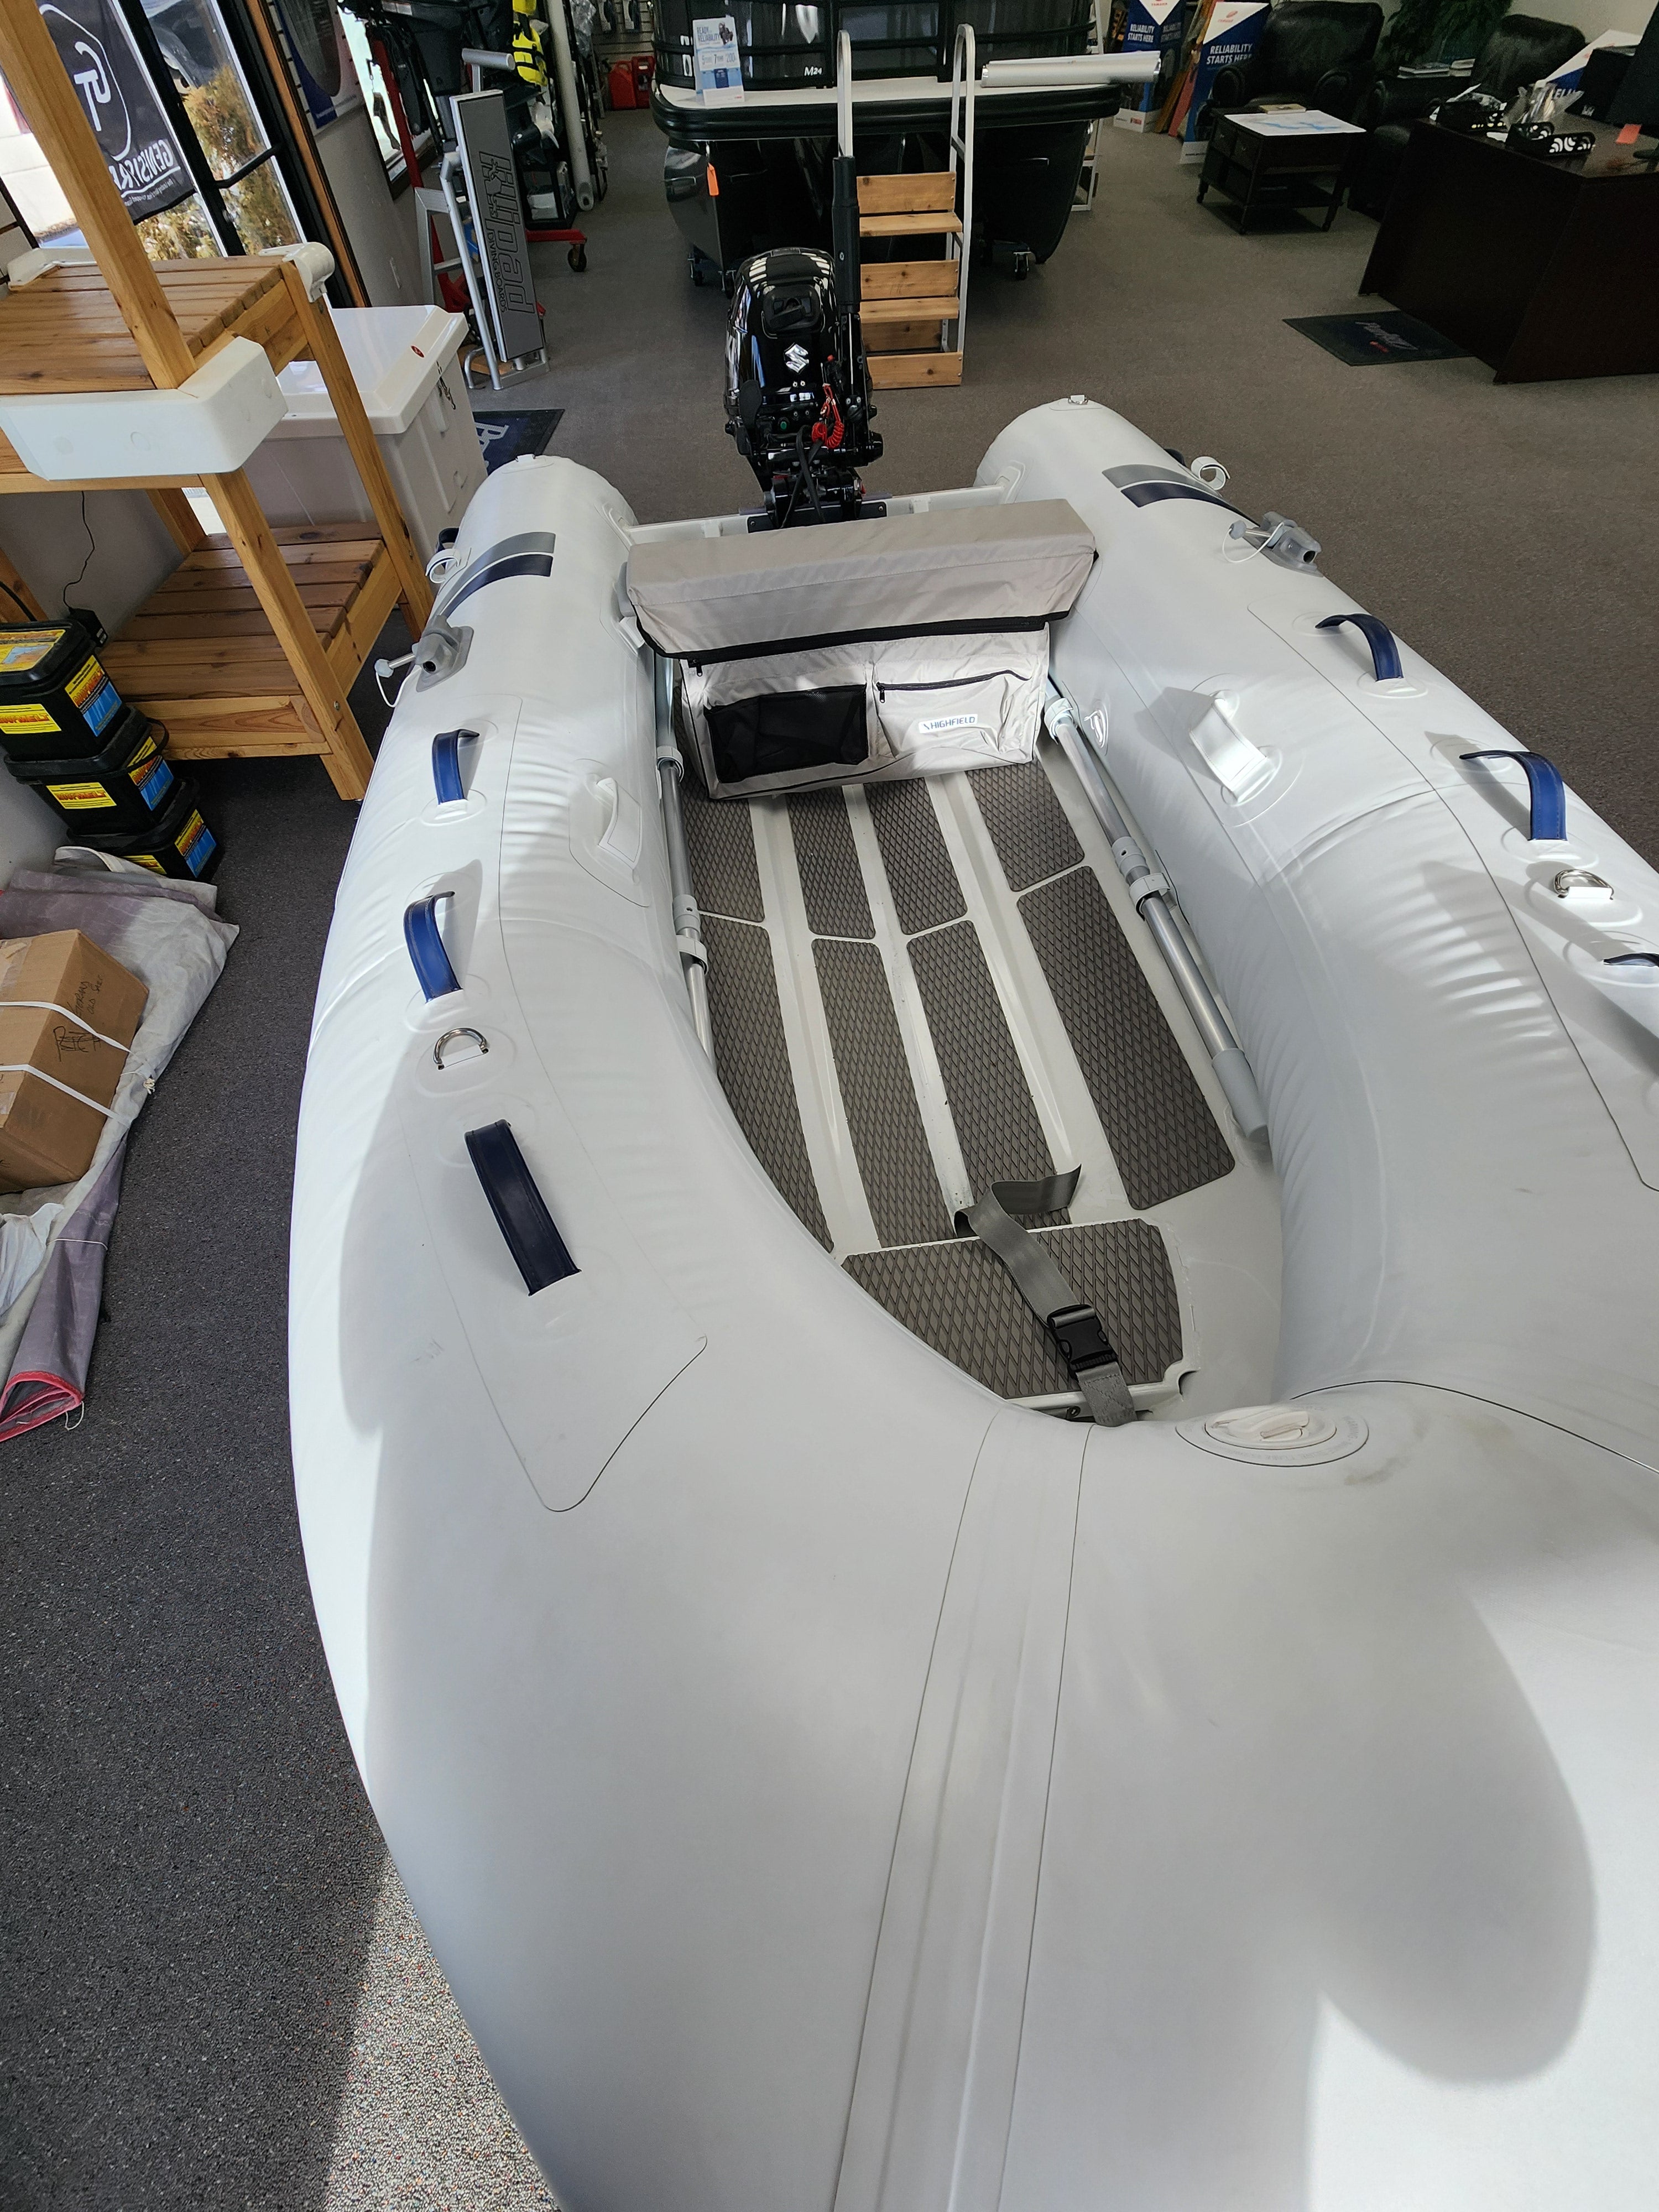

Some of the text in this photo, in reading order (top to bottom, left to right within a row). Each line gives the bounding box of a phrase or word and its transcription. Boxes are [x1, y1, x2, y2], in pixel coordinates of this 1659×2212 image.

[1130, 23, 1155, 34] RELIABILITY
[1128, 33, 1154, 43] STARTS HERE
[1210, 43, 1253, 54] RELIABILITY
[1206, 55, 1233, 65] STARTS
[487, 232, 508, 313] DIVING BOARDS
[930, 716, 976, 729] HIGHFIELD
